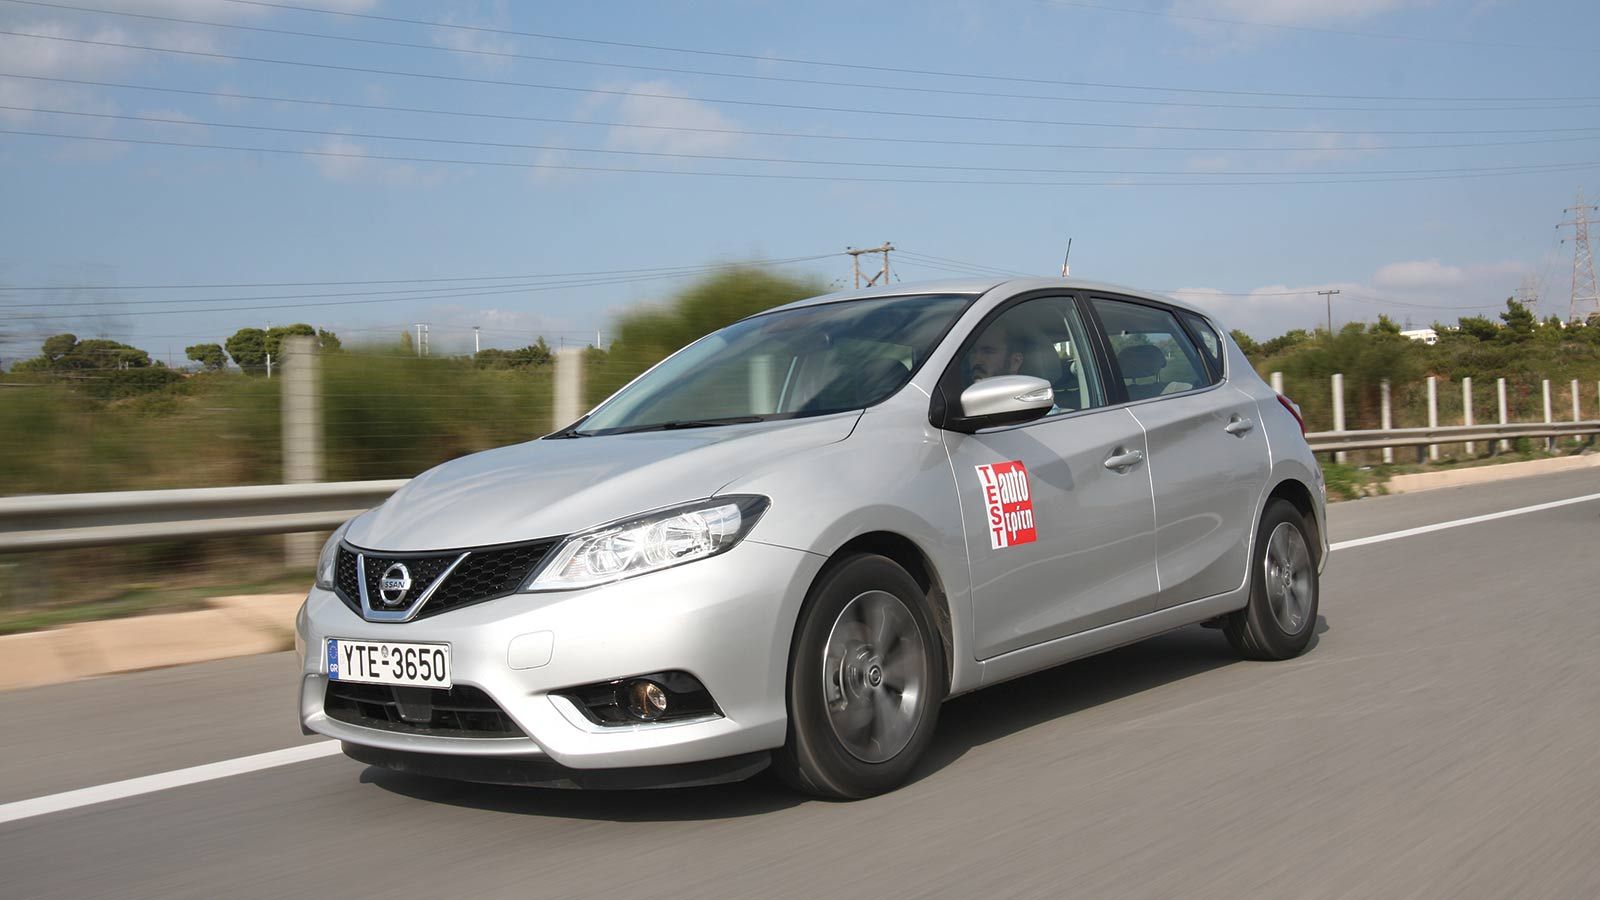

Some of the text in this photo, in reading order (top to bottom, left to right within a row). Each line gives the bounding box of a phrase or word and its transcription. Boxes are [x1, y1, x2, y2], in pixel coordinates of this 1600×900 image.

[998, 465, 1029, 504] auto
[978, 466, 1003, 546] TEST
[330, 663, 339, 673] GR
